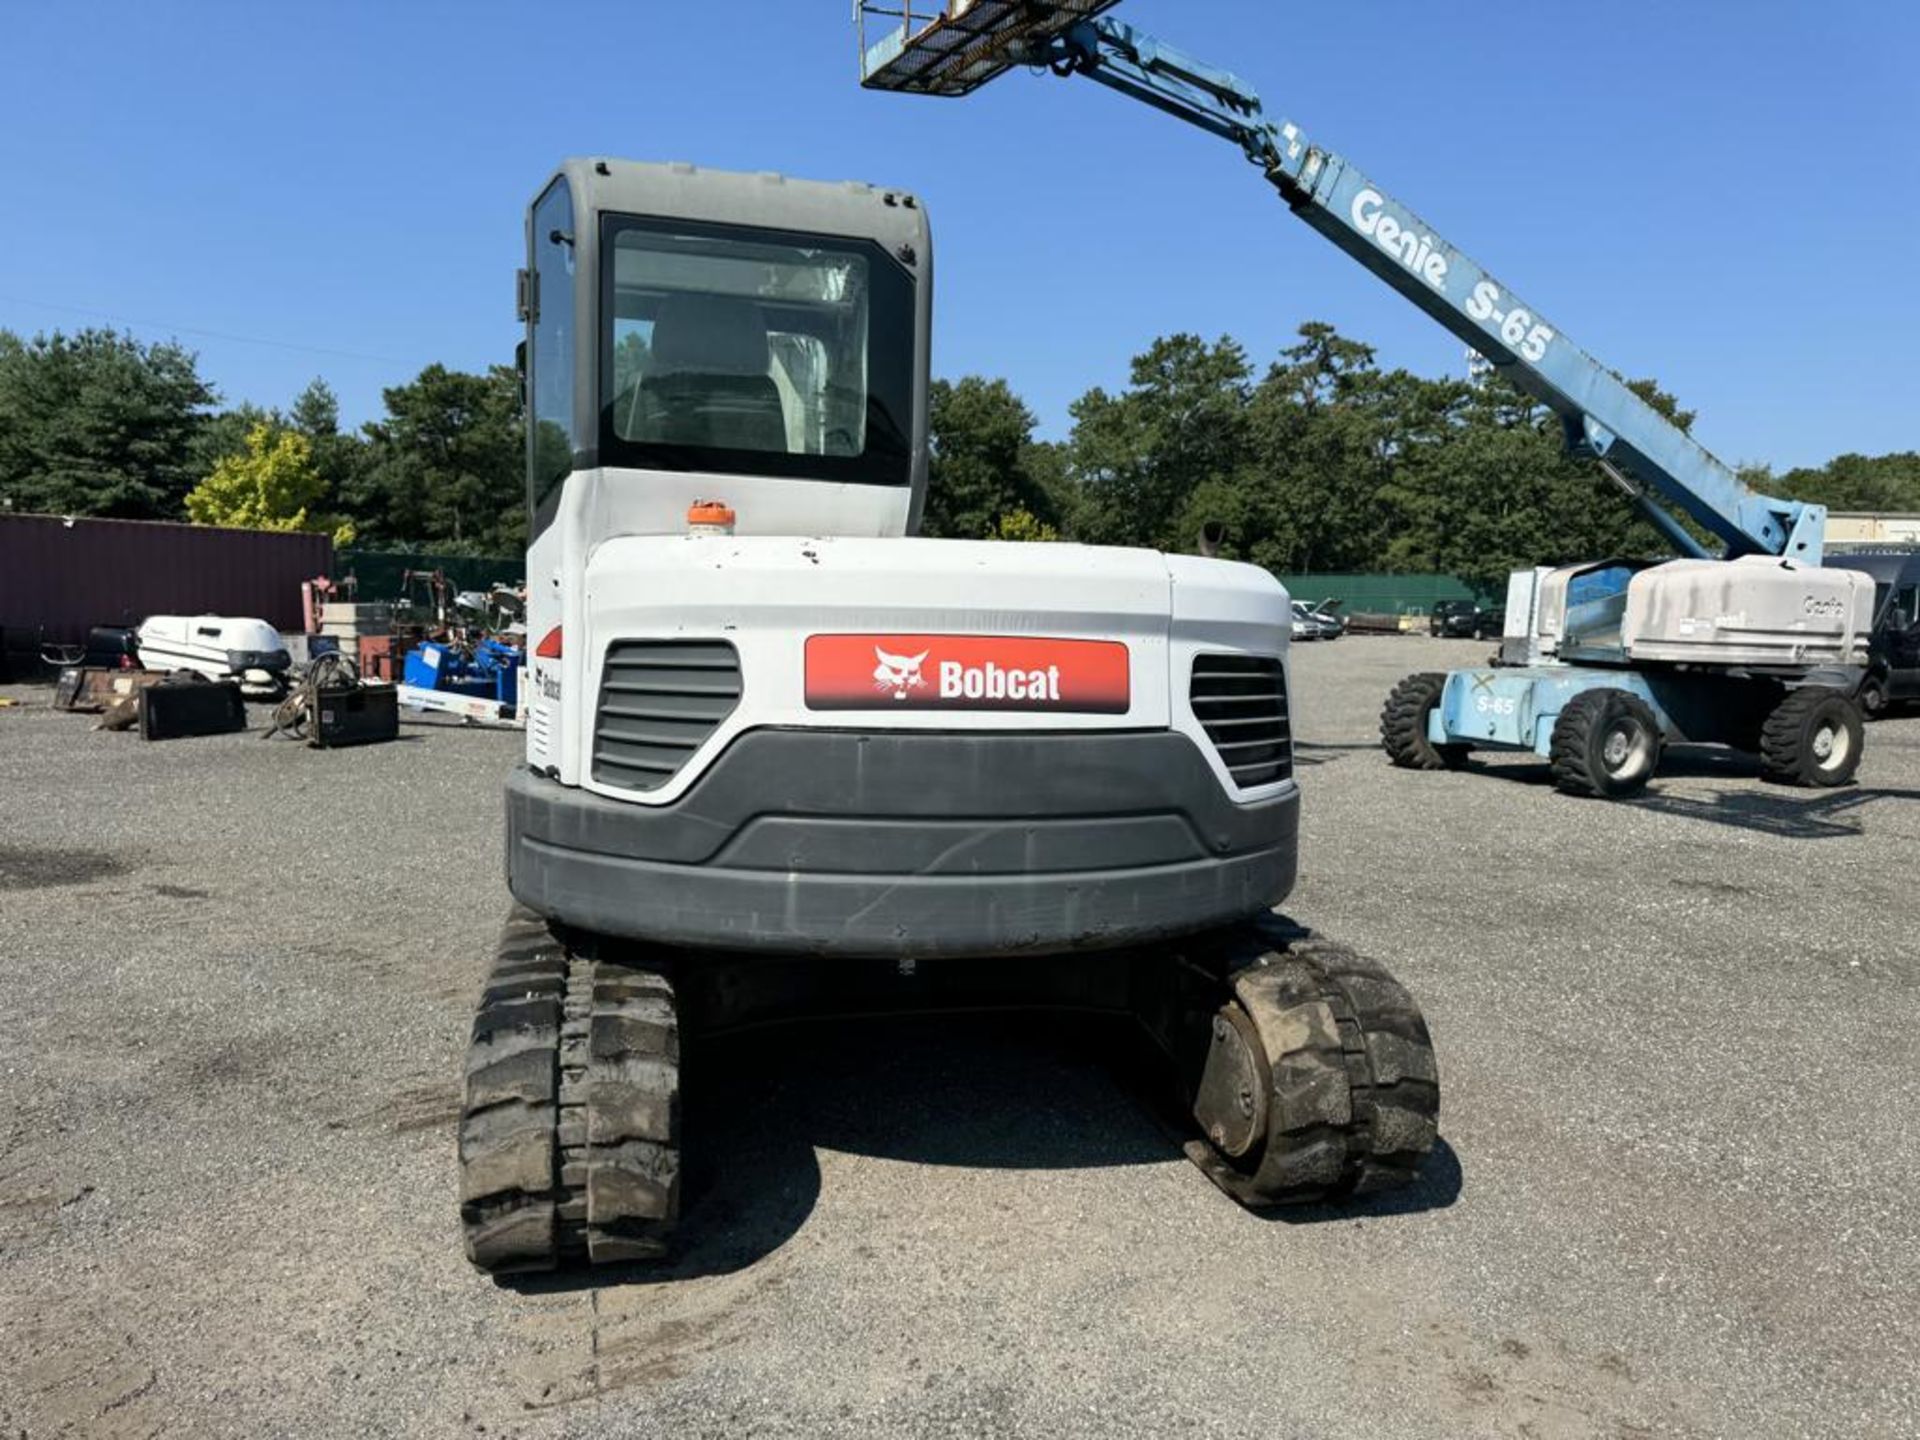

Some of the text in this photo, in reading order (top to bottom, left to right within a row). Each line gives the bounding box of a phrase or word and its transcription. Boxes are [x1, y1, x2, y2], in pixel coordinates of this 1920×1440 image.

[1352, 189, 1554, 362] Genie S-65
[939, 661, 1060, 700] Bobcat
[1477, 695, 1515, 714] S-65
